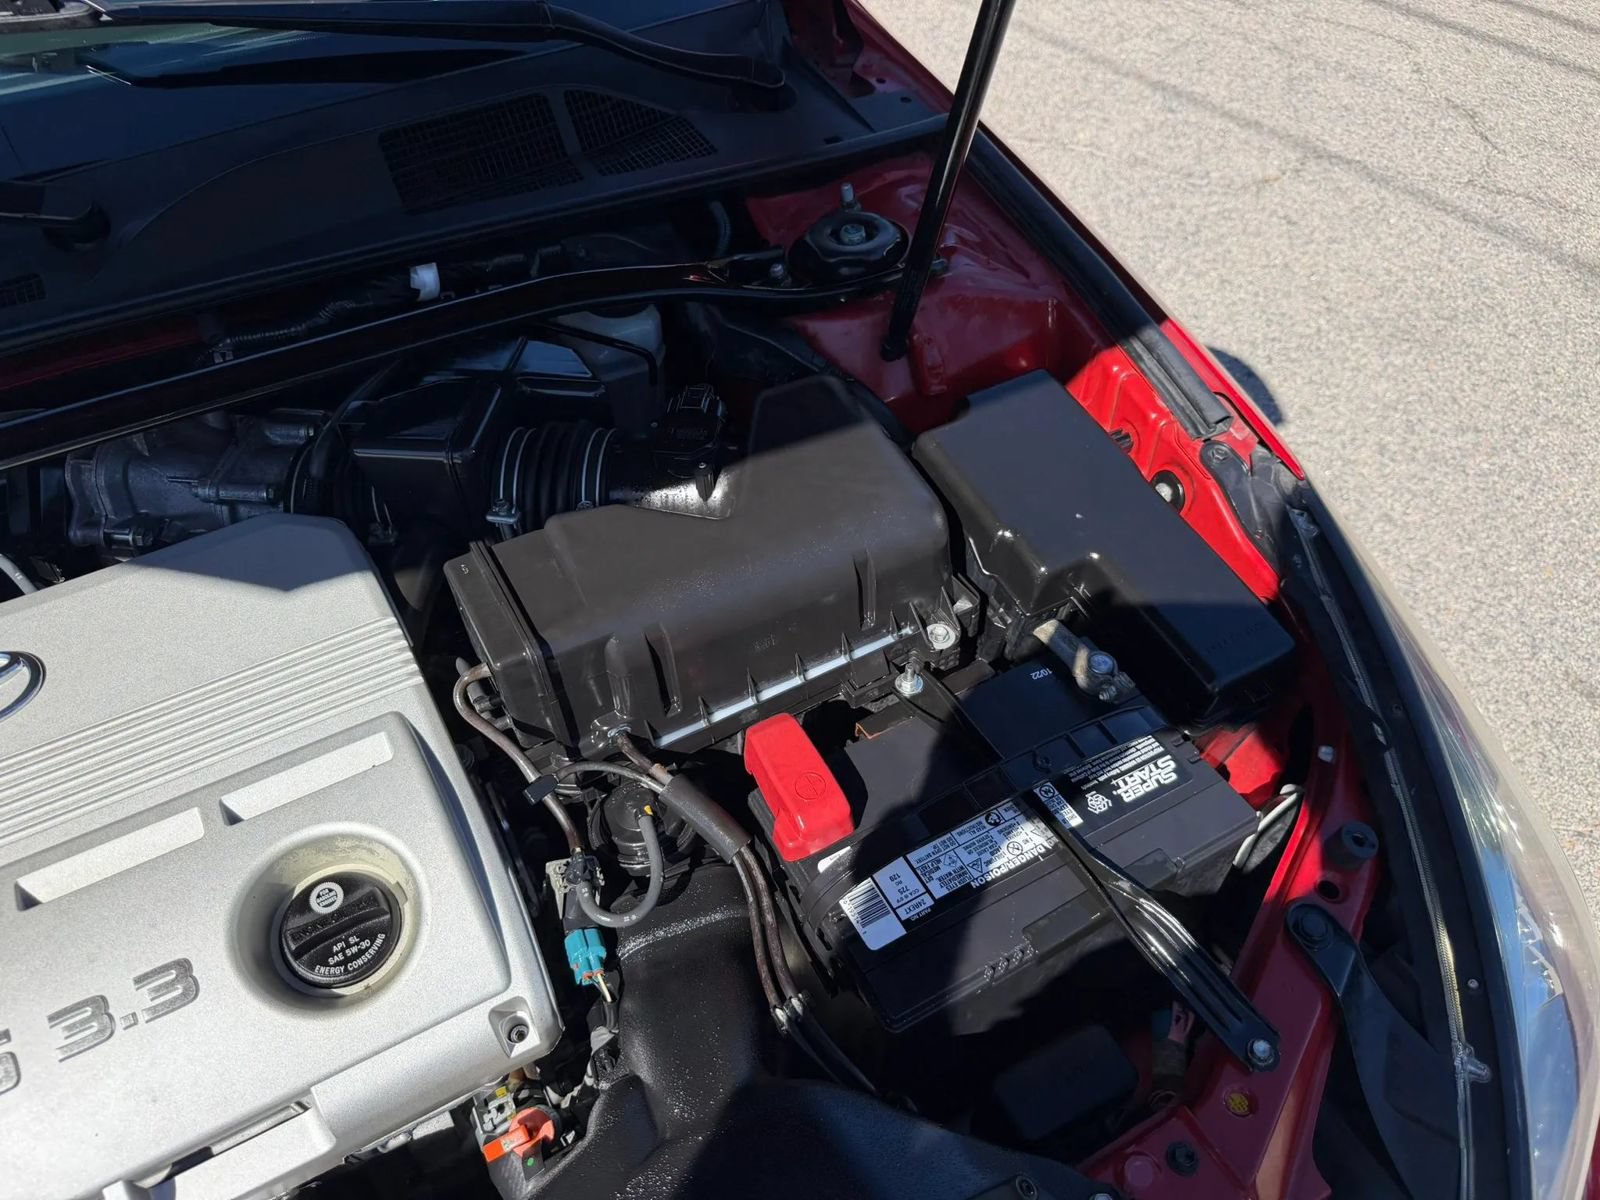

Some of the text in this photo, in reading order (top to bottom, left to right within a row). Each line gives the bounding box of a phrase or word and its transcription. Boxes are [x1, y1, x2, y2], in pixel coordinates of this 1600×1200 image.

[1115, 754, 1176, 791] START
[1121, 769, 1178, 802] SUPER
[889, 872, 900, 881] 120
[970, 844, 1045, 888] DANGER/POISON
[897, 885, 909, 895] 725
[907, 887, 919, 896] CCA
[903, 898, 926, 914] 24REXT
[314, 933, 386, 975] ENERGY CONSERVING
[328, 939, 371, 965] SAE 5W-30
[333, 935, 360, 952] API SL
[46, 957, 201, 1063] 3.3
